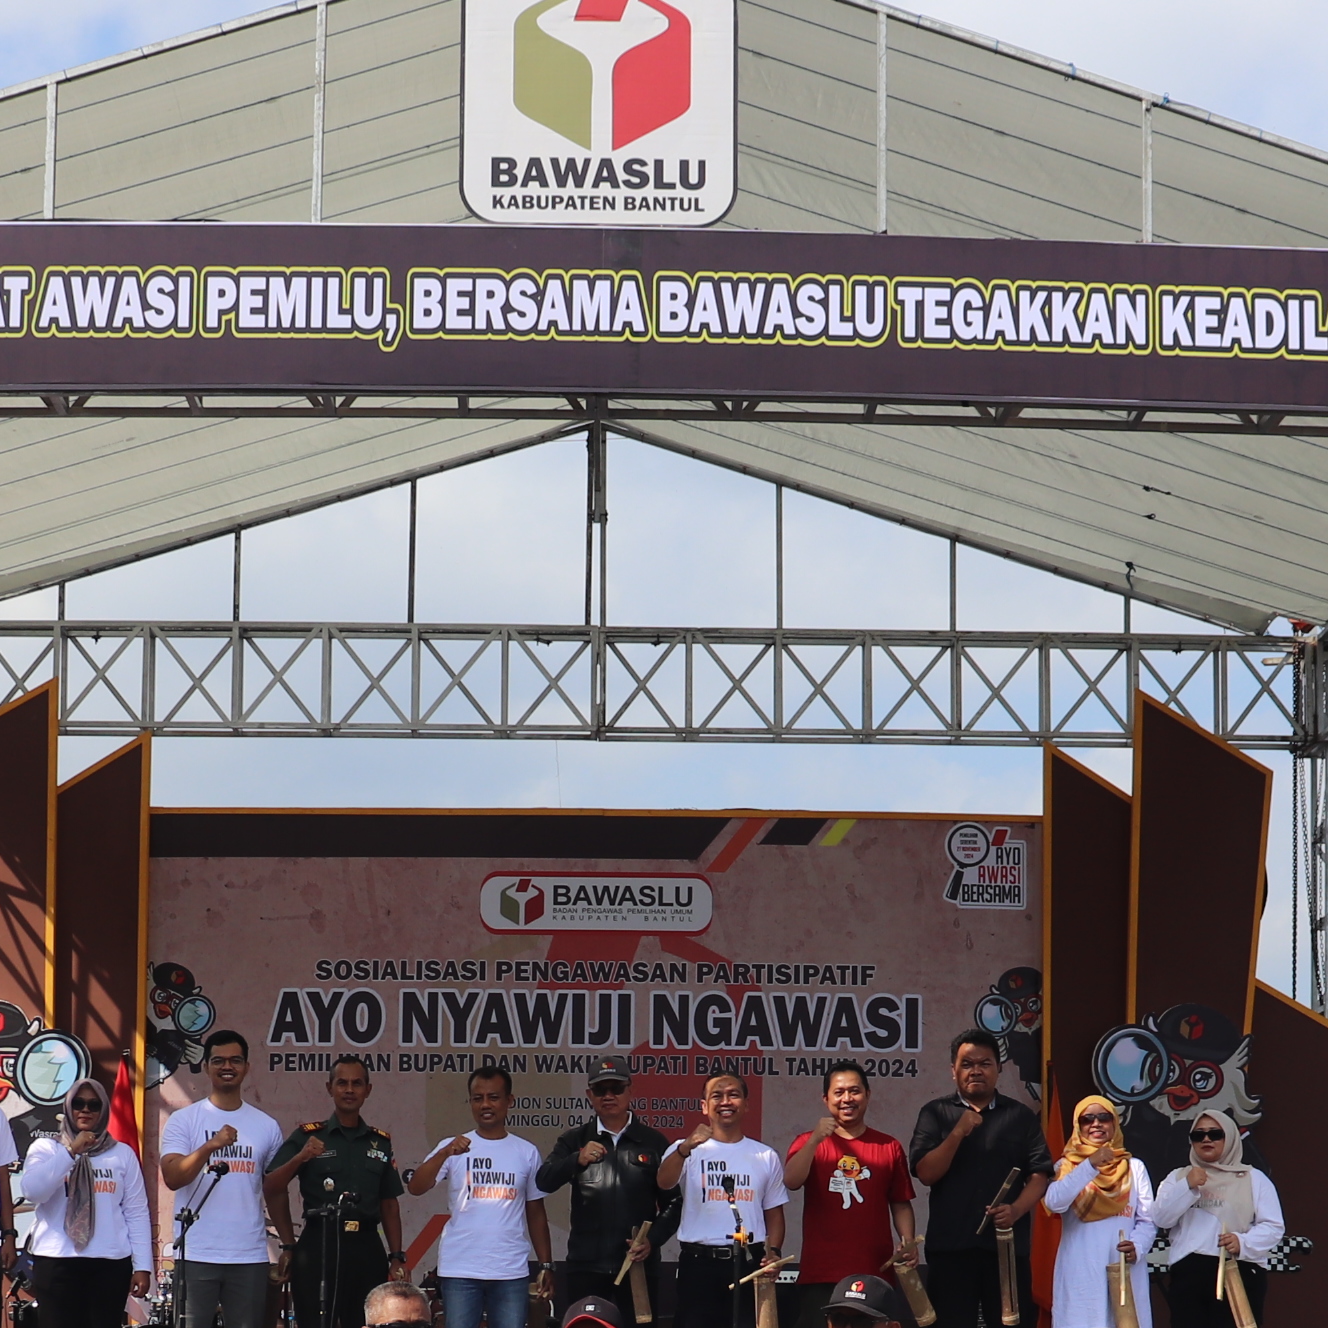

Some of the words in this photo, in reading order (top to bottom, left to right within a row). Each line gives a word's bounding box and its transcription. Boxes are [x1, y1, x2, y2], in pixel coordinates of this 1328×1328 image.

[490, 157, 707, 190] BAWASLU
[492, 194, 616, 211] KABUPATEN
[623, 196, 705, 213] BANTUL
[37, 275, 191, 329] AWASI
[204, 275, 399, 342] PEMILU,
[412, 277, 646, 332] BERSAMA
[658, 280, 885, 338] BAWASLU
[896, 285, 1147, 346] TEGAKKAN
[996, 847, 1021, 865] AYO
[978, 865, 1021, 885] AWASI
[552, 885, 694, 907] BAWASLU
[962, 884, 1021, 903] BERSAMA
[315, 960, 487, 983] SOSIALISASI
[495, 961, 688, 984] PENGAWASAN
[697, 963, 876, 986] PARTISIPATIF
[269, 989, 384, 1046] AYO
[401, 989, 633, 1048] NYAWIJI
[652, 992, 920, 1051] NGAWASI
[270, 1053, 391, 1072] PEMILAN
[399, 1053, 474, 1072] BUPATI
[482, 1054, 527, 1073] DAN
[534, 1055, 599, 1074] WAKI
[612, 1055, 688, 1075] UPATI
[695, 1056, 779, 1076] BANTUL
[785, 1057, 857, 1077] TAH
[864, 1058, 918, 1078] 2024
[545, 1097, 593, 1110] SULTAN
[651, 1098, 703, 1111] BANTUL
[504, 1114, 564, 1129] MINGGU,
[568, 1114, 583, 1128] 04
[653, 1115, 684, 1129] 2024
[472, 1157, 492, 1170] AYO
[707, 1161, 727, 1172] AYO
[472, 1171, 516, 1186] NYAWIJI
[472, 1187, 518, 1200] NGAWASI
